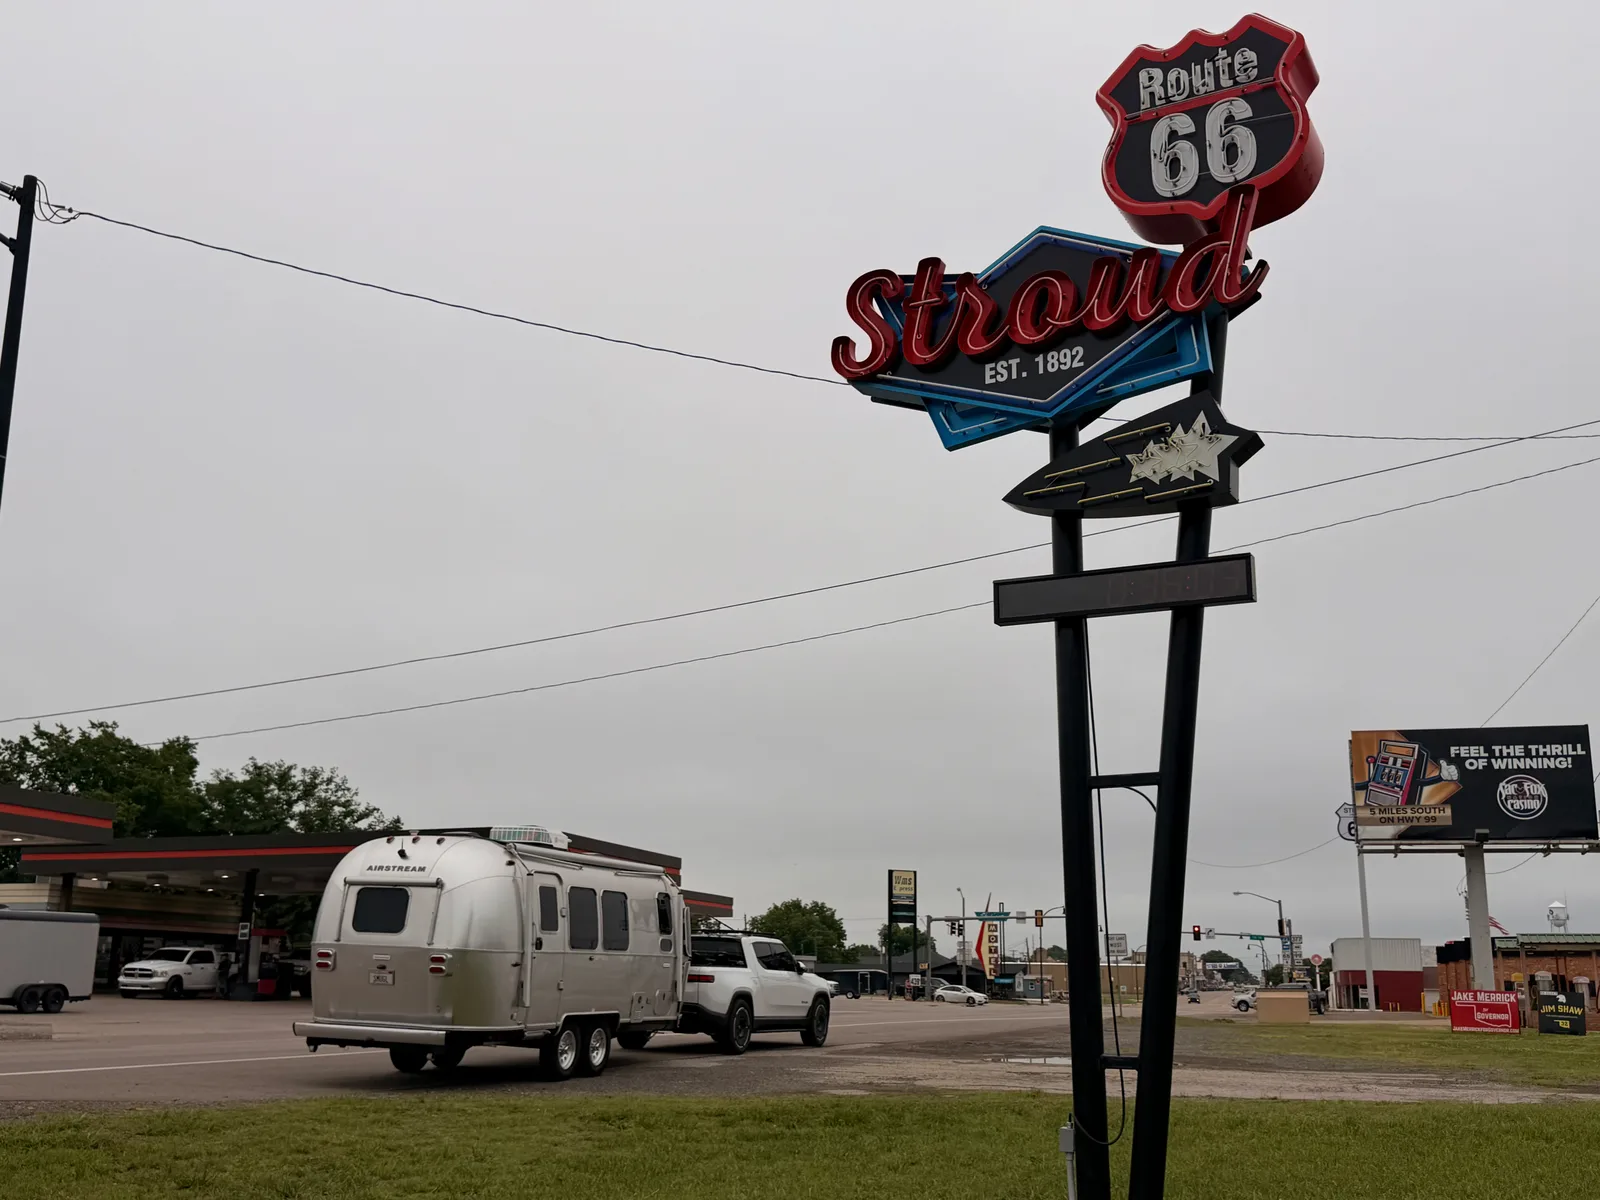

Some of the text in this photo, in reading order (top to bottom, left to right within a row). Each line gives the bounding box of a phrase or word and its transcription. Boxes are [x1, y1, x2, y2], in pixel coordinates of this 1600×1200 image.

[1138, 46, 1260, 110] Route
[1149, 97, 1258, 198] 66
[831, 183, 1270, 379] Stroud
[984, 346, 1085, 384] EST. 1892
[1450, 743, 1586, 758] FEEL THE THRILL
[1465, 757, 1572, 770] OF WINNING!
[1378, 807, 1408, 815] MILES
[1410, 807, 1445, 815] SOUTH
[1424, 815, 1437, 823] 99
[894, 875, 912, 885] Wms
[988, 924, 997, 976] MOTEL
[1451, 991, 1516, 1002] JAKE MERRICK
[1477, 1012, 1509, 1020] GOVERNOR
[1540, 1004, 1584, 1015] JIM SHAW
